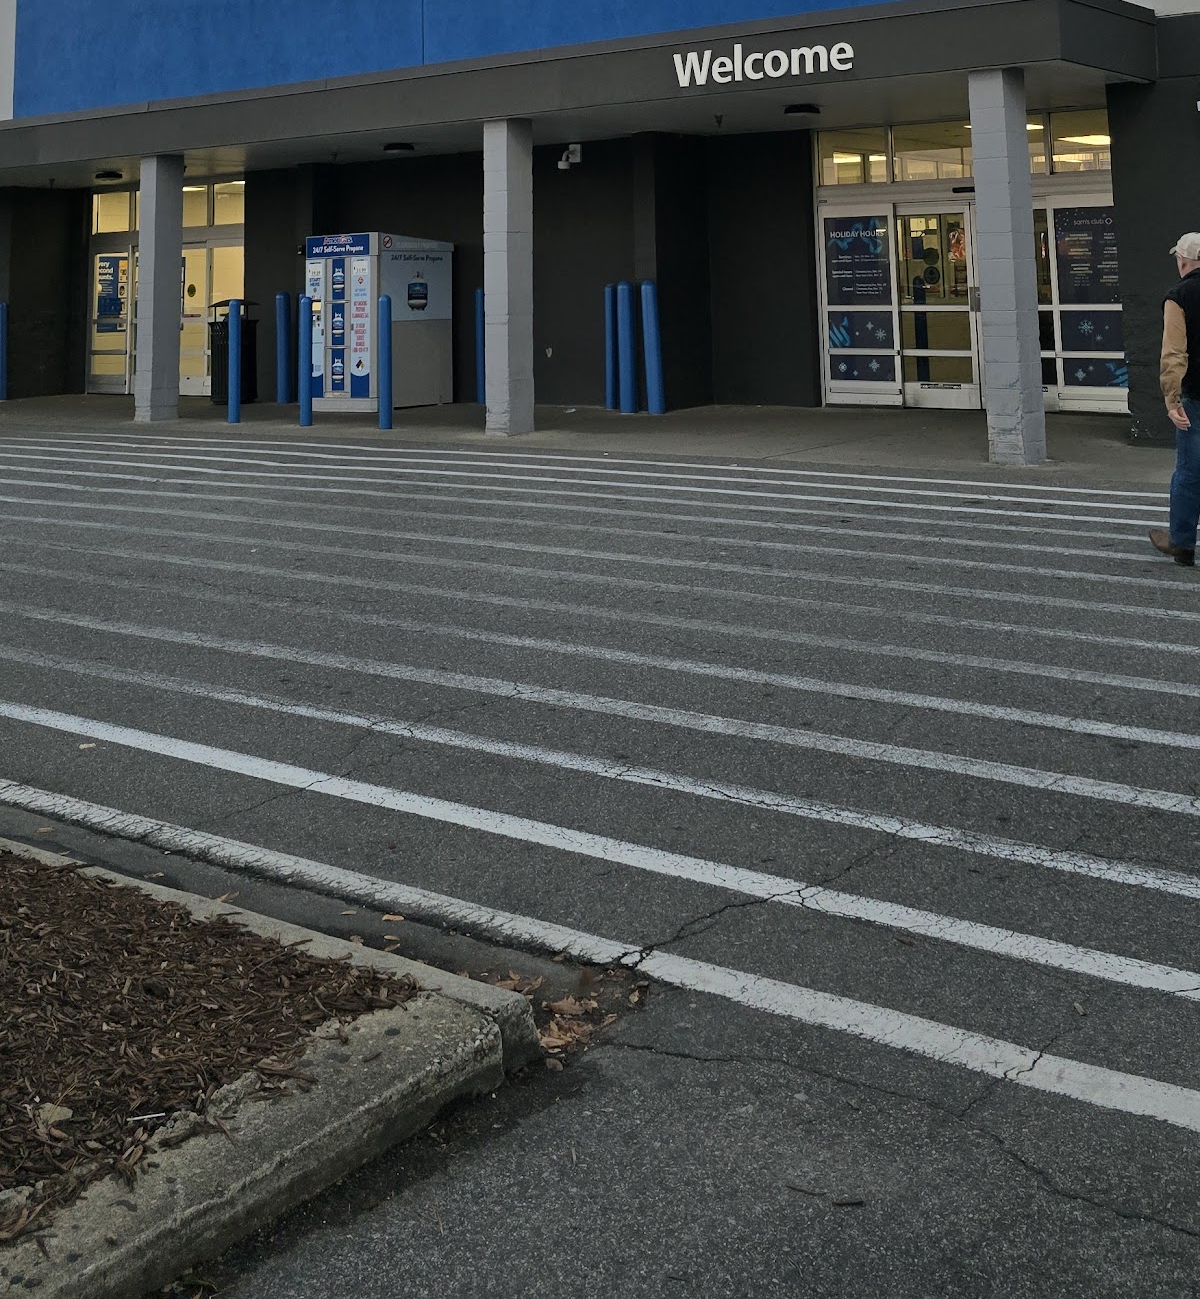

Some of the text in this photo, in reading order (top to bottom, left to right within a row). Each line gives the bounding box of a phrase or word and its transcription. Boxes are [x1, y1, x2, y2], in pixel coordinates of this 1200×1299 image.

[673, 42, 854, 88] Welcome
[1073, 218, 1090, 226] sam's
[312, 244, 364, 254] 24/7 Self-Serve Propane
[425, 254, 443, 263] Propane
